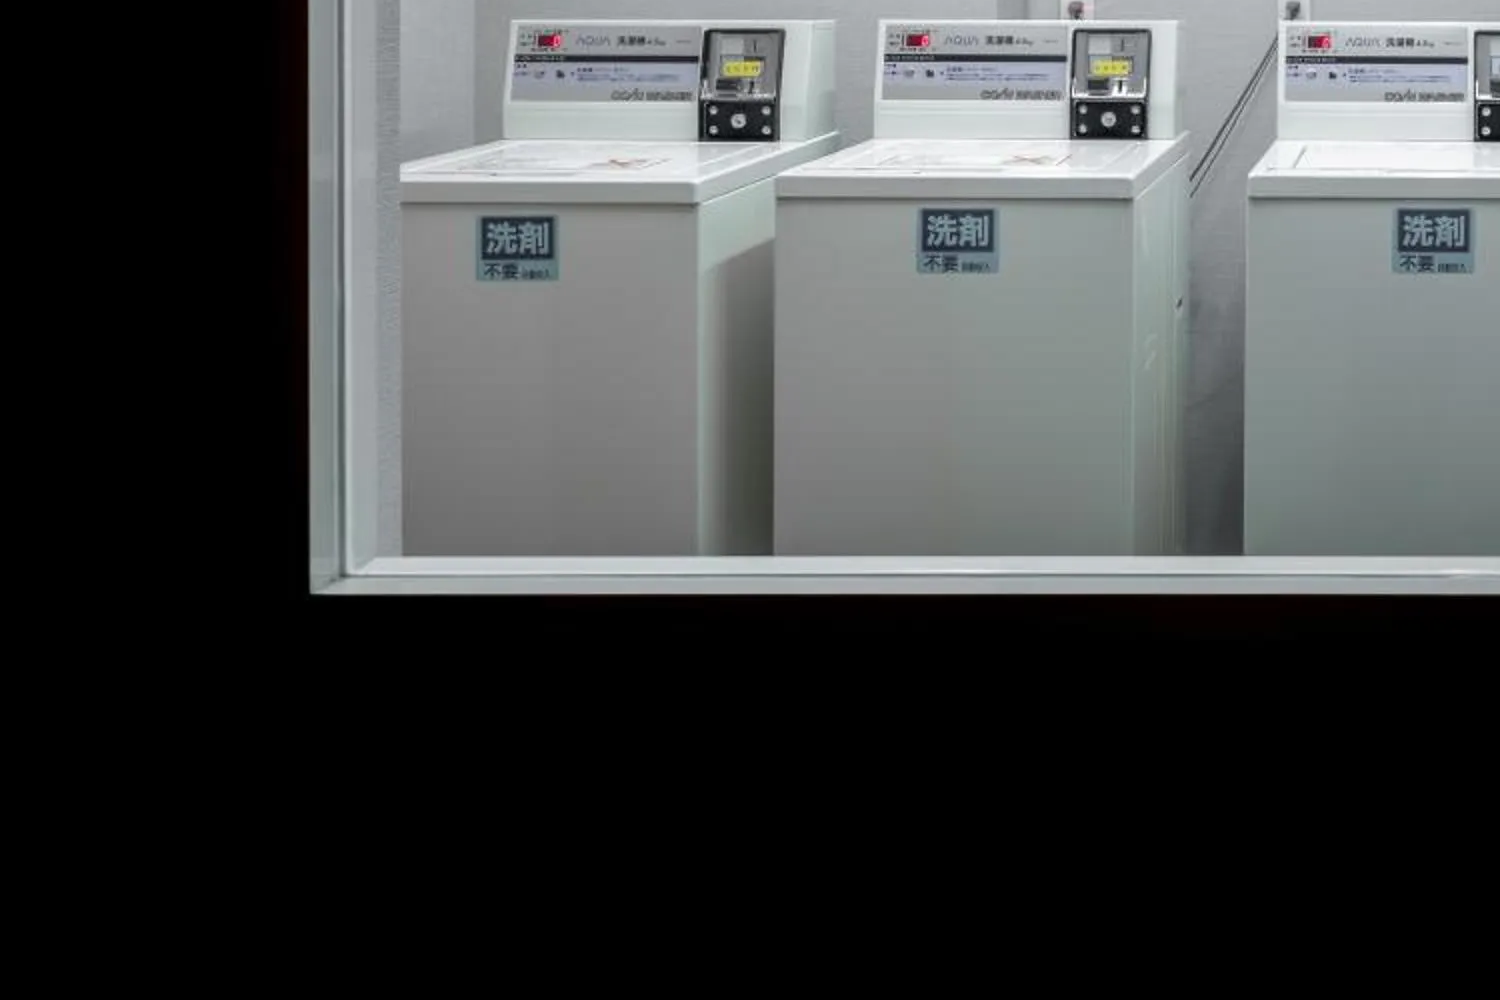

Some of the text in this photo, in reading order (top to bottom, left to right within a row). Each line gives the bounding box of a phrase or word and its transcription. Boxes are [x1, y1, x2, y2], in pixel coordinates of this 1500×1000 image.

[487, 221, 549, 255] 洗剤
[927, 214, 989, 247] 洗剤
[1403, 214, 1465, 247] 洗剤
